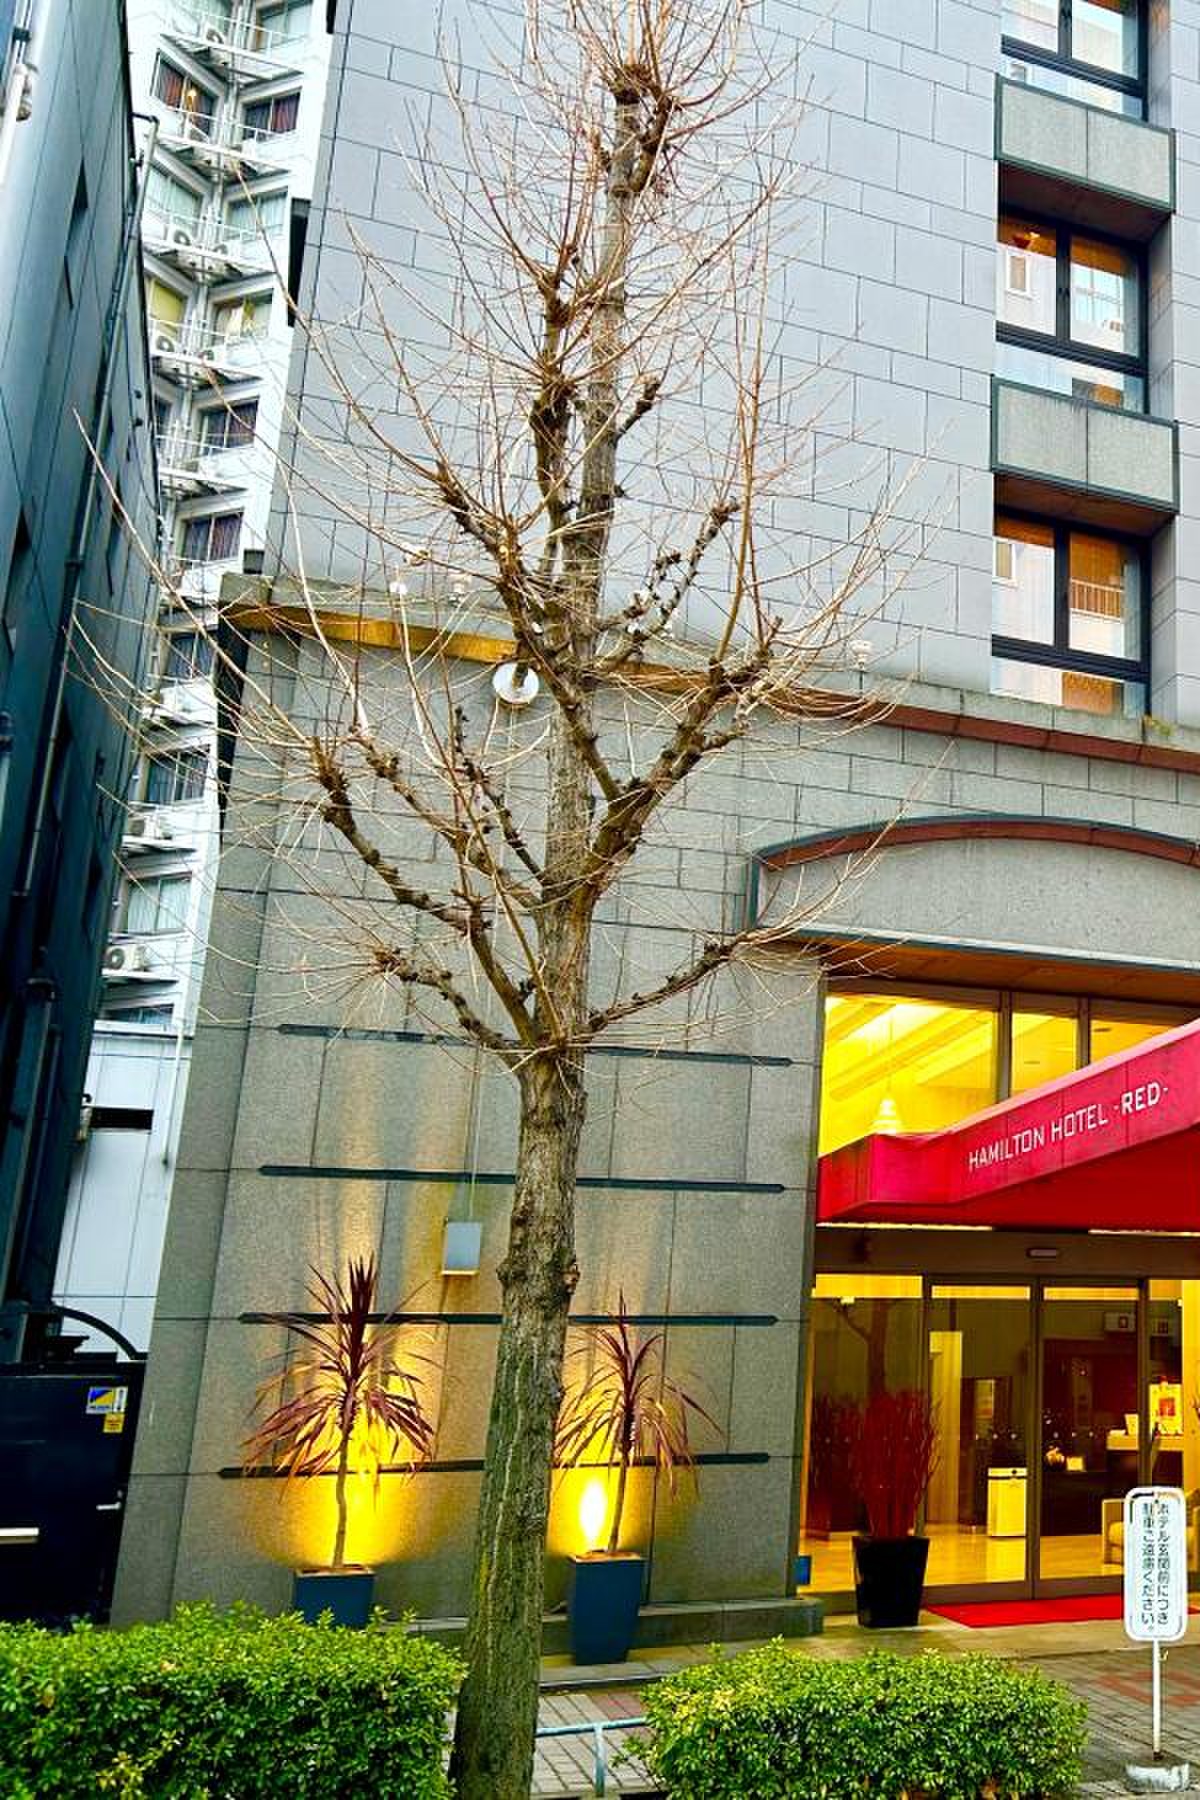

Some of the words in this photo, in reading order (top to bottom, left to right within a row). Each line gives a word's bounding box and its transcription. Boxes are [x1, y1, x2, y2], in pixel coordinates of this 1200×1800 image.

[968, 1124, 1045, 1172] HAMILTON
[1051, 1103, 1109, 1143] HOTEL
[1157, 1502, 1170, 1626] ホテル玄関前につき
